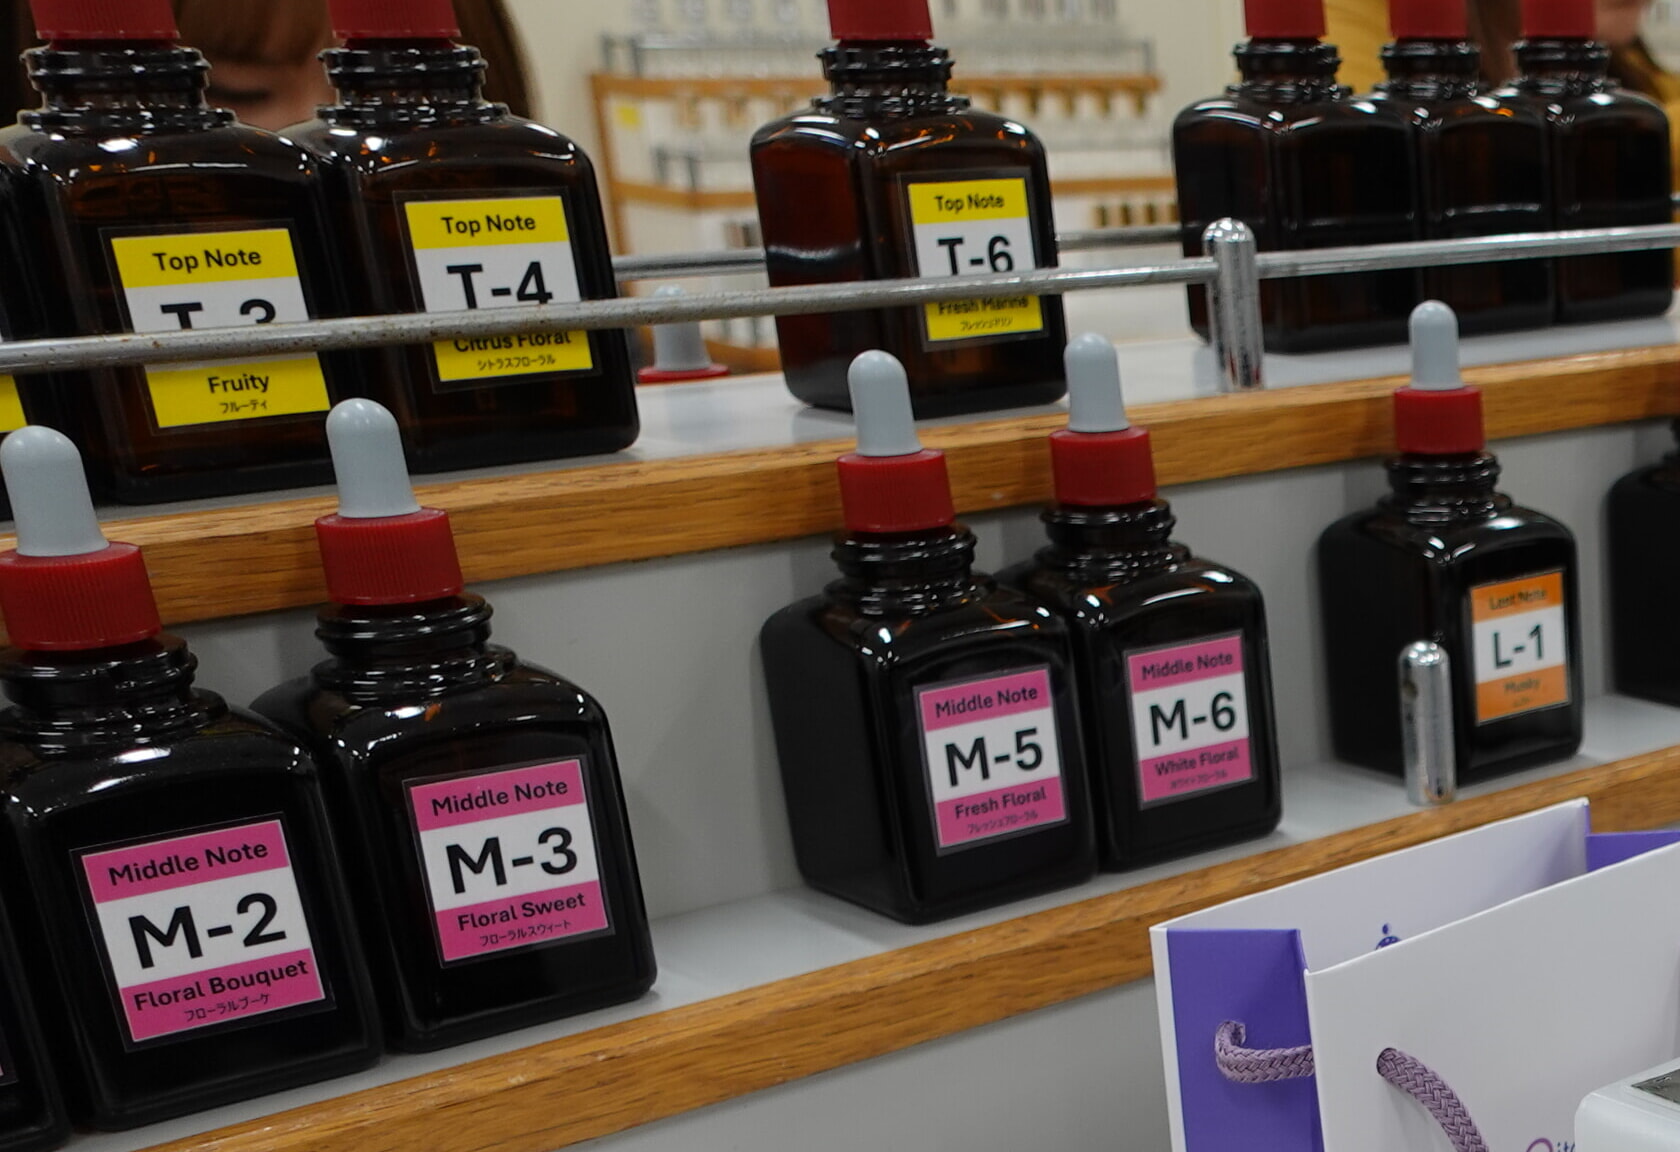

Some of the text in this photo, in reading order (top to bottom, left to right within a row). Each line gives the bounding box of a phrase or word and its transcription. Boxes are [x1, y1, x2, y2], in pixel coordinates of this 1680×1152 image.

[935, 194, 1005, 214] Top Note
[441, 215, 536, 237] Top Note
[152, 249, 262, 274] Top Note
[936, 235, 1014, 275] T-6
[446, 261, 553, 309] T-4
[159, 299, 277, 330] T3
[453, 331, 571, 353] Citrus Floral
[477, 354, 556, 372] シトラスフローラル
[207, 374, 270, 394] Fruity
[219, 399, 268, 414] フルーティ
[1489, 595, 1516, 611] Last
[1493, 623, 1543, 669] L-1
[1141, 652, 1233, 680] Middle Note
[935, 686, 1038, 718] Middle Note
[1150, 691, 1236, 746] M-6
[945, 727, 1043, 788] M-5
[1155, 747, 1239, 777] White Floral
[431, 780, 569, 817] Middle Note
[955, 786, 1047, 820] Fresh Floral
[107, 842, 269, 887] Middle Note
[446, 827, 578, 894] M-3
[457, 892, 586, 931] Floral Sweet
[128, 892, 287, 970] M-2
[479, 919, 571, 946] フローラルスウィート
[133, 959, 309, 1012] Floral Bouquet
[184, 993, 271, 1022] フローラルブーケ
